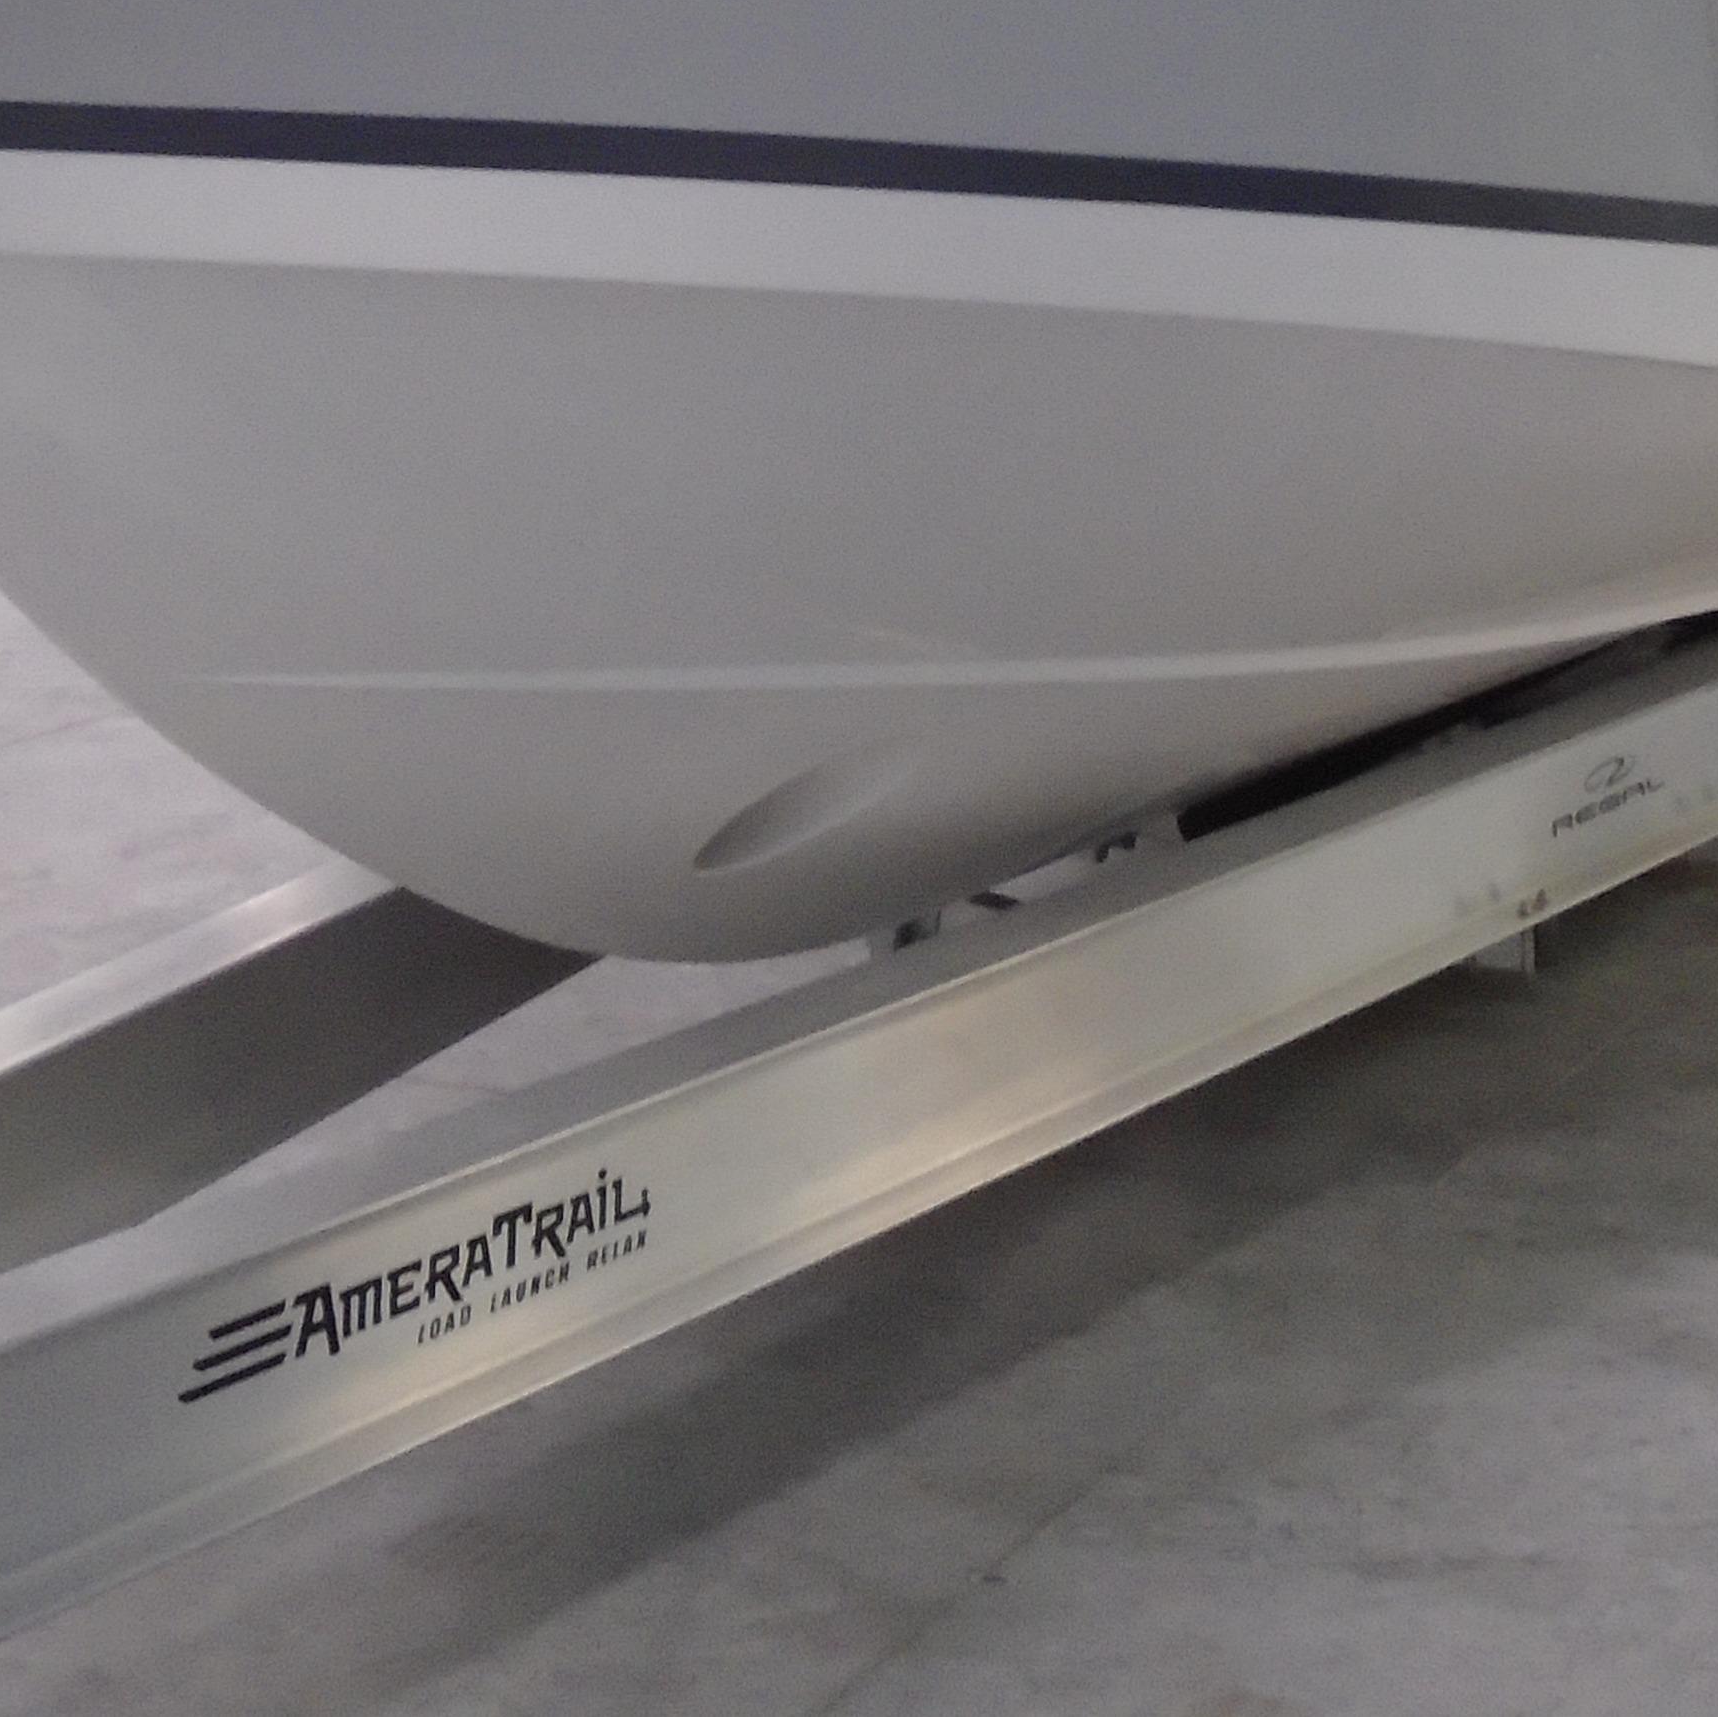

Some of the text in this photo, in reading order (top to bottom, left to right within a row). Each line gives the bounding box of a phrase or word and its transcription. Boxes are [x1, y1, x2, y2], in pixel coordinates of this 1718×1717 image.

[416, 1230, 648, 1344] LOAD LAUNCH RELAX
